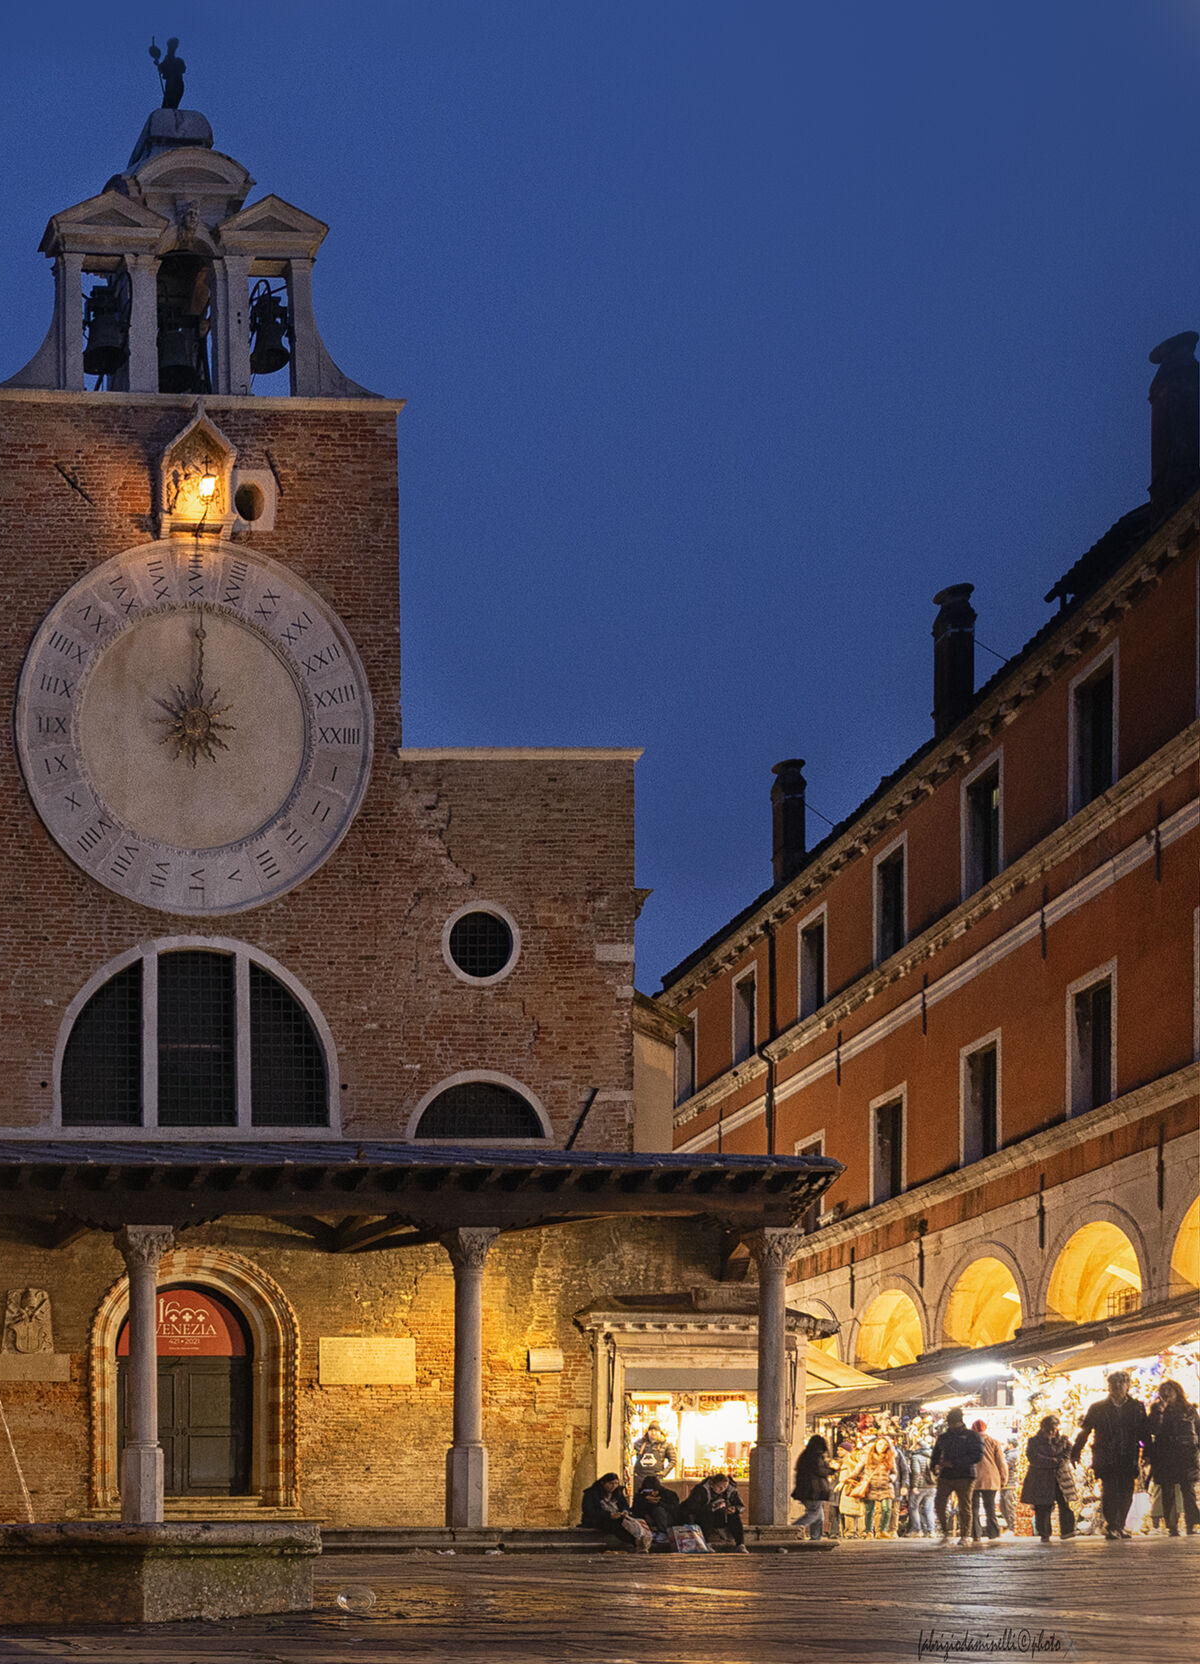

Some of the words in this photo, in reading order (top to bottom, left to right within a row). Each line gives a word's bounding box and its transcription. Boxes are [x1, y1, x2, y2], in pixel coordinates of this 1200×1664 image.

[147, 560, 171, 600] XVII
[223, 560, 248, 607] XVIIII
[108, 575, 139, 614] XVI
[254, 588, 281, 621] XX
[76, 605, 108, 633] XV
[281, 611, 313, 646] XXI
[301, 643, 341, 676] XXII
[314, 684, 356, 709] XXIII
[318, 727, 360, 745] XXIIII
[331, 766, 338, 782] I
[64, 791, 82, 812] X
[311, 800, 331, 822] II
[76, 820, 112, 853] VIIII
[285, 828, 309, 854] III
[110, 846, 139, 878] VIII
[149, 862, 170, 888] VII
[227, 868, 243, 882] V
[256, 849, 280, 879] IIII
[189, 868, 205, 890] VI
